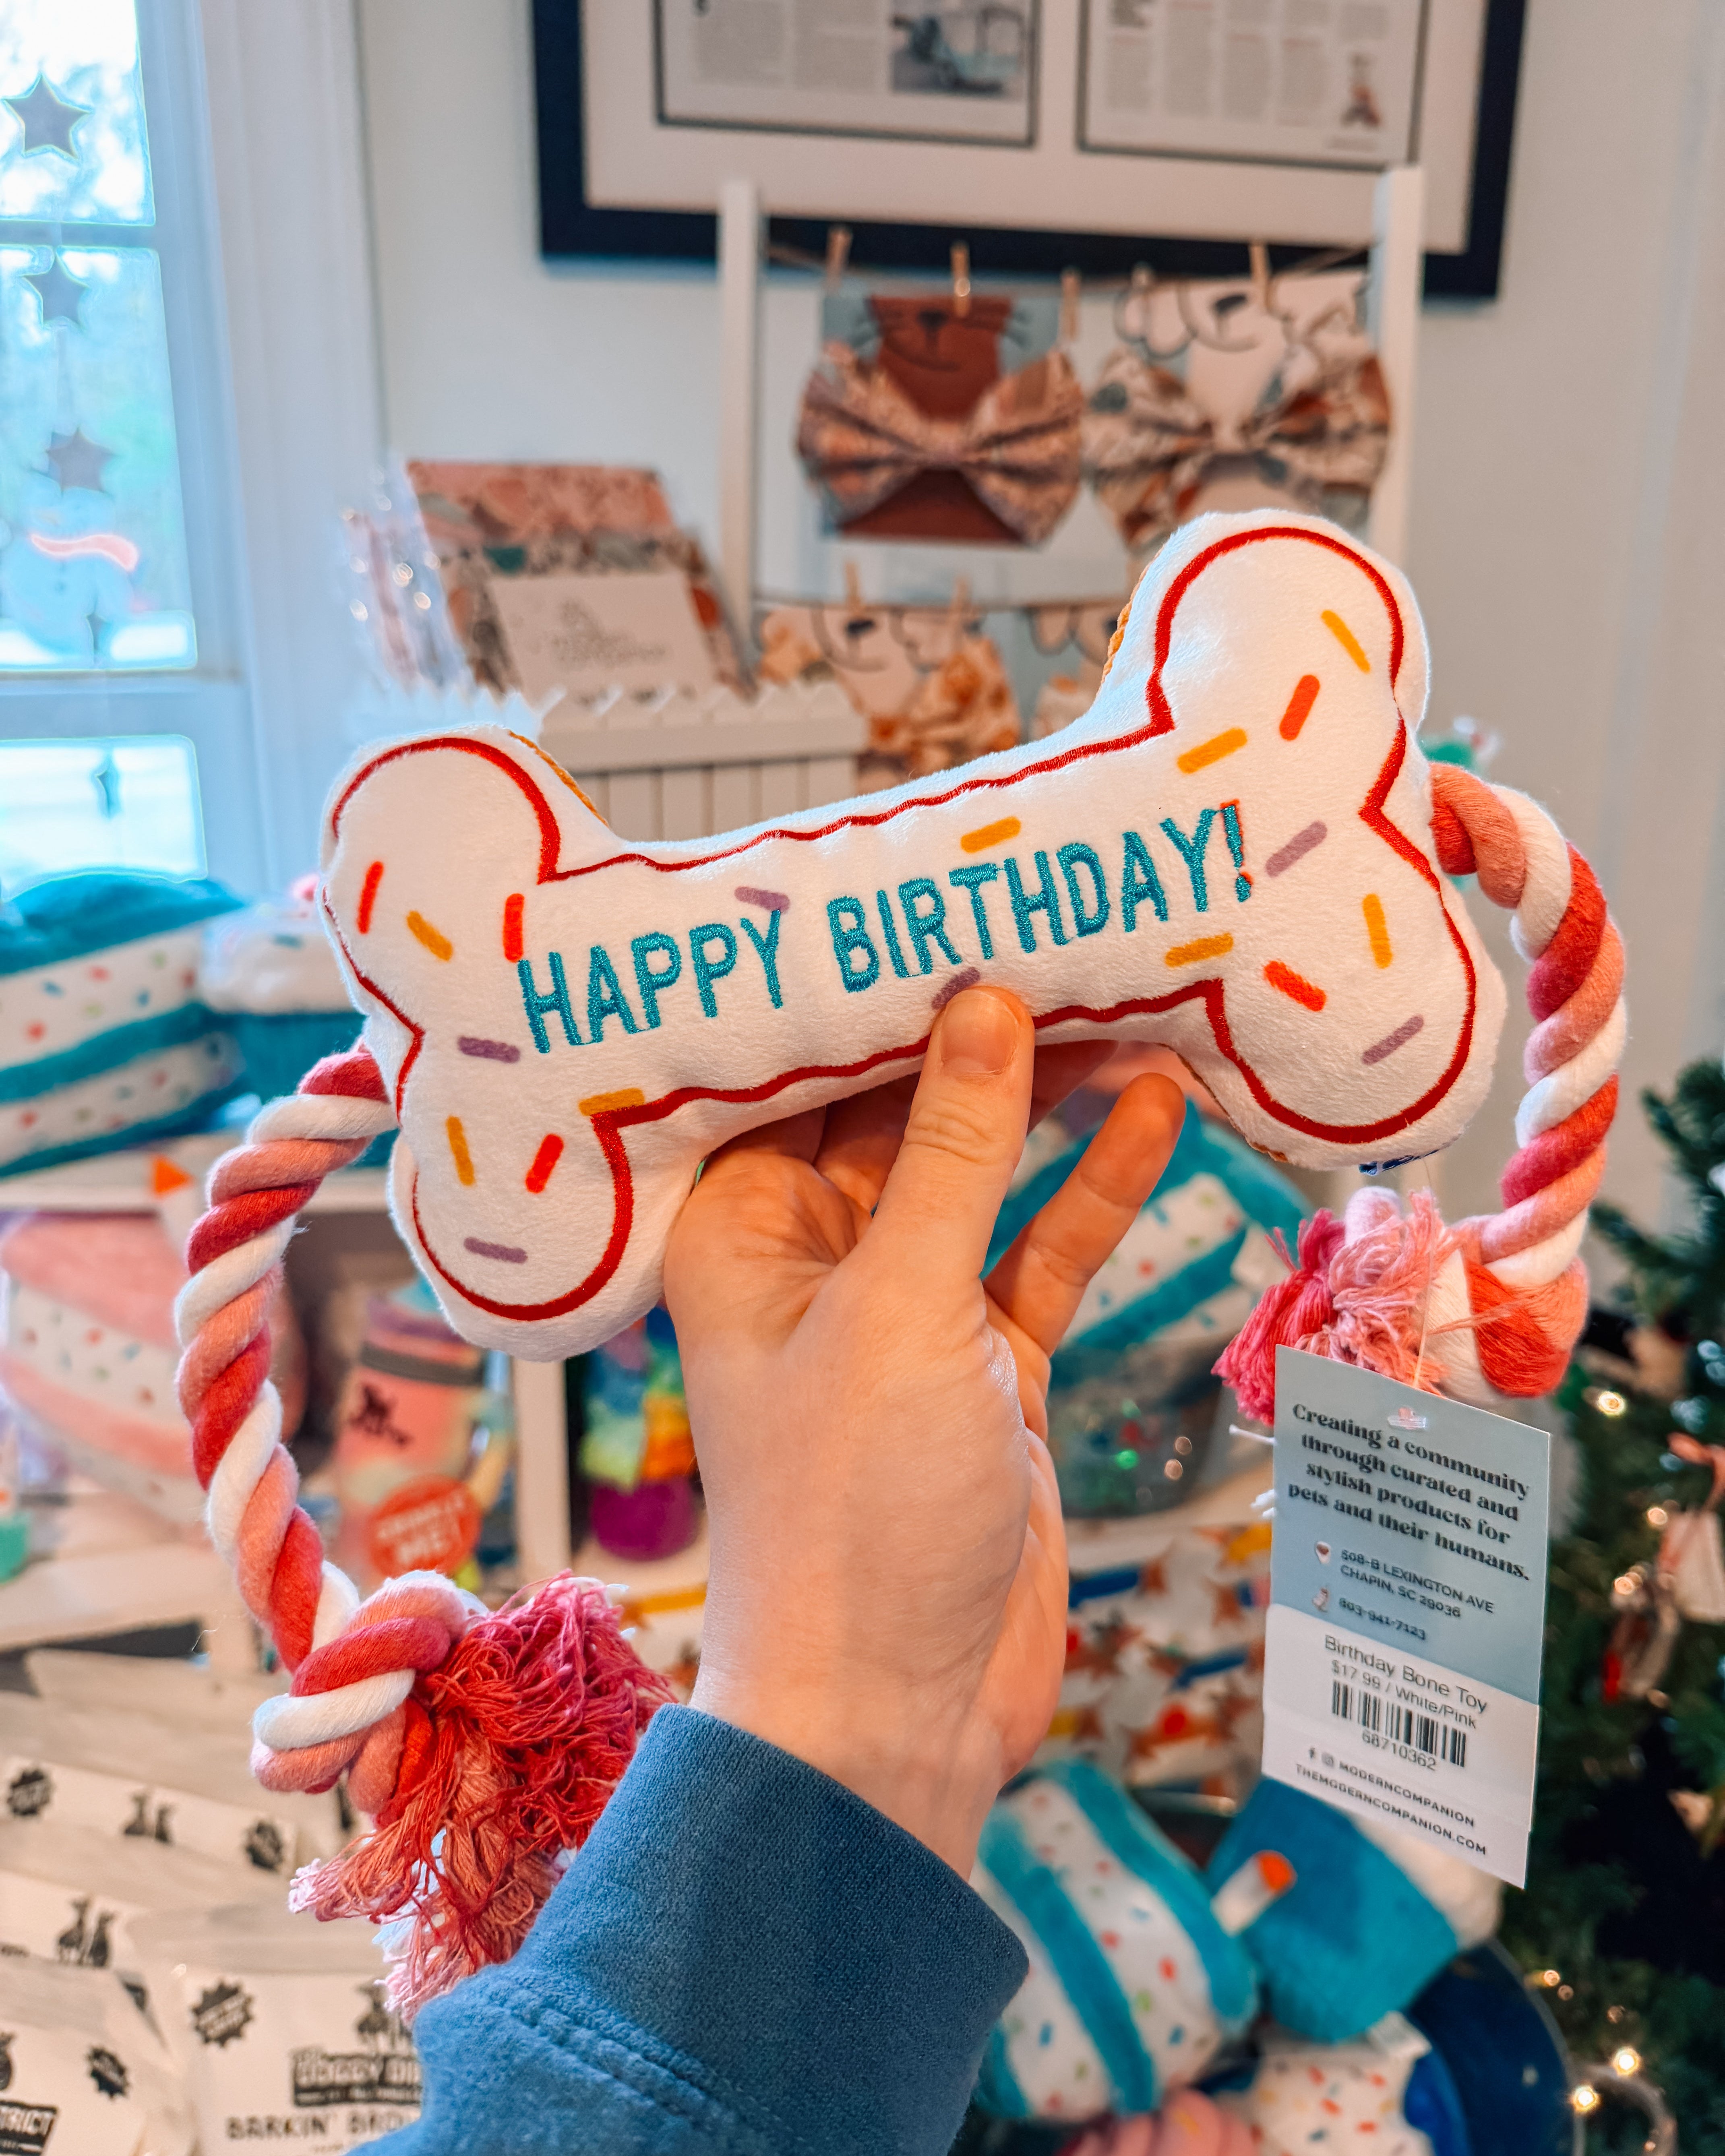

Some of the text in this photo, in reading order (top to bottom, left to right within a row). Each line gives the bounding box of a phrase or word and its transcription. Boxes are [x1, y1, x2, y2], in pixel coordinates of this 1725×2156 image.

[518, 800, 1252, 1054] HAPPY BIRTHDAY!
[1293, 1404, 1530, 1500] Creating a community
[1301, 1434, 1518, 1521] through curated and
[1288, 1484, 1530, 1581] pets and their humans.
[1307, 1462, 1510, 1544] stylish products for
[1340, 1565, 1461, 1617] CHAPIN, SC 29036
[1384, 1563, 1463, 1601] LEXINGTON
[1466, 1595, 1494, 1614] AVE
[1325, 1635, 1487, 1714] Birthday Bone Toy
[1396, 1685, 1476, 1730] White/Pink
[1362, 1731, 1437, 1771] 68710362
[1296, 1764, 1486, 1855] THEMODERNCOMPANION.COM
[1339, 1761, 1474, 1827] MODERNCOMPANION
